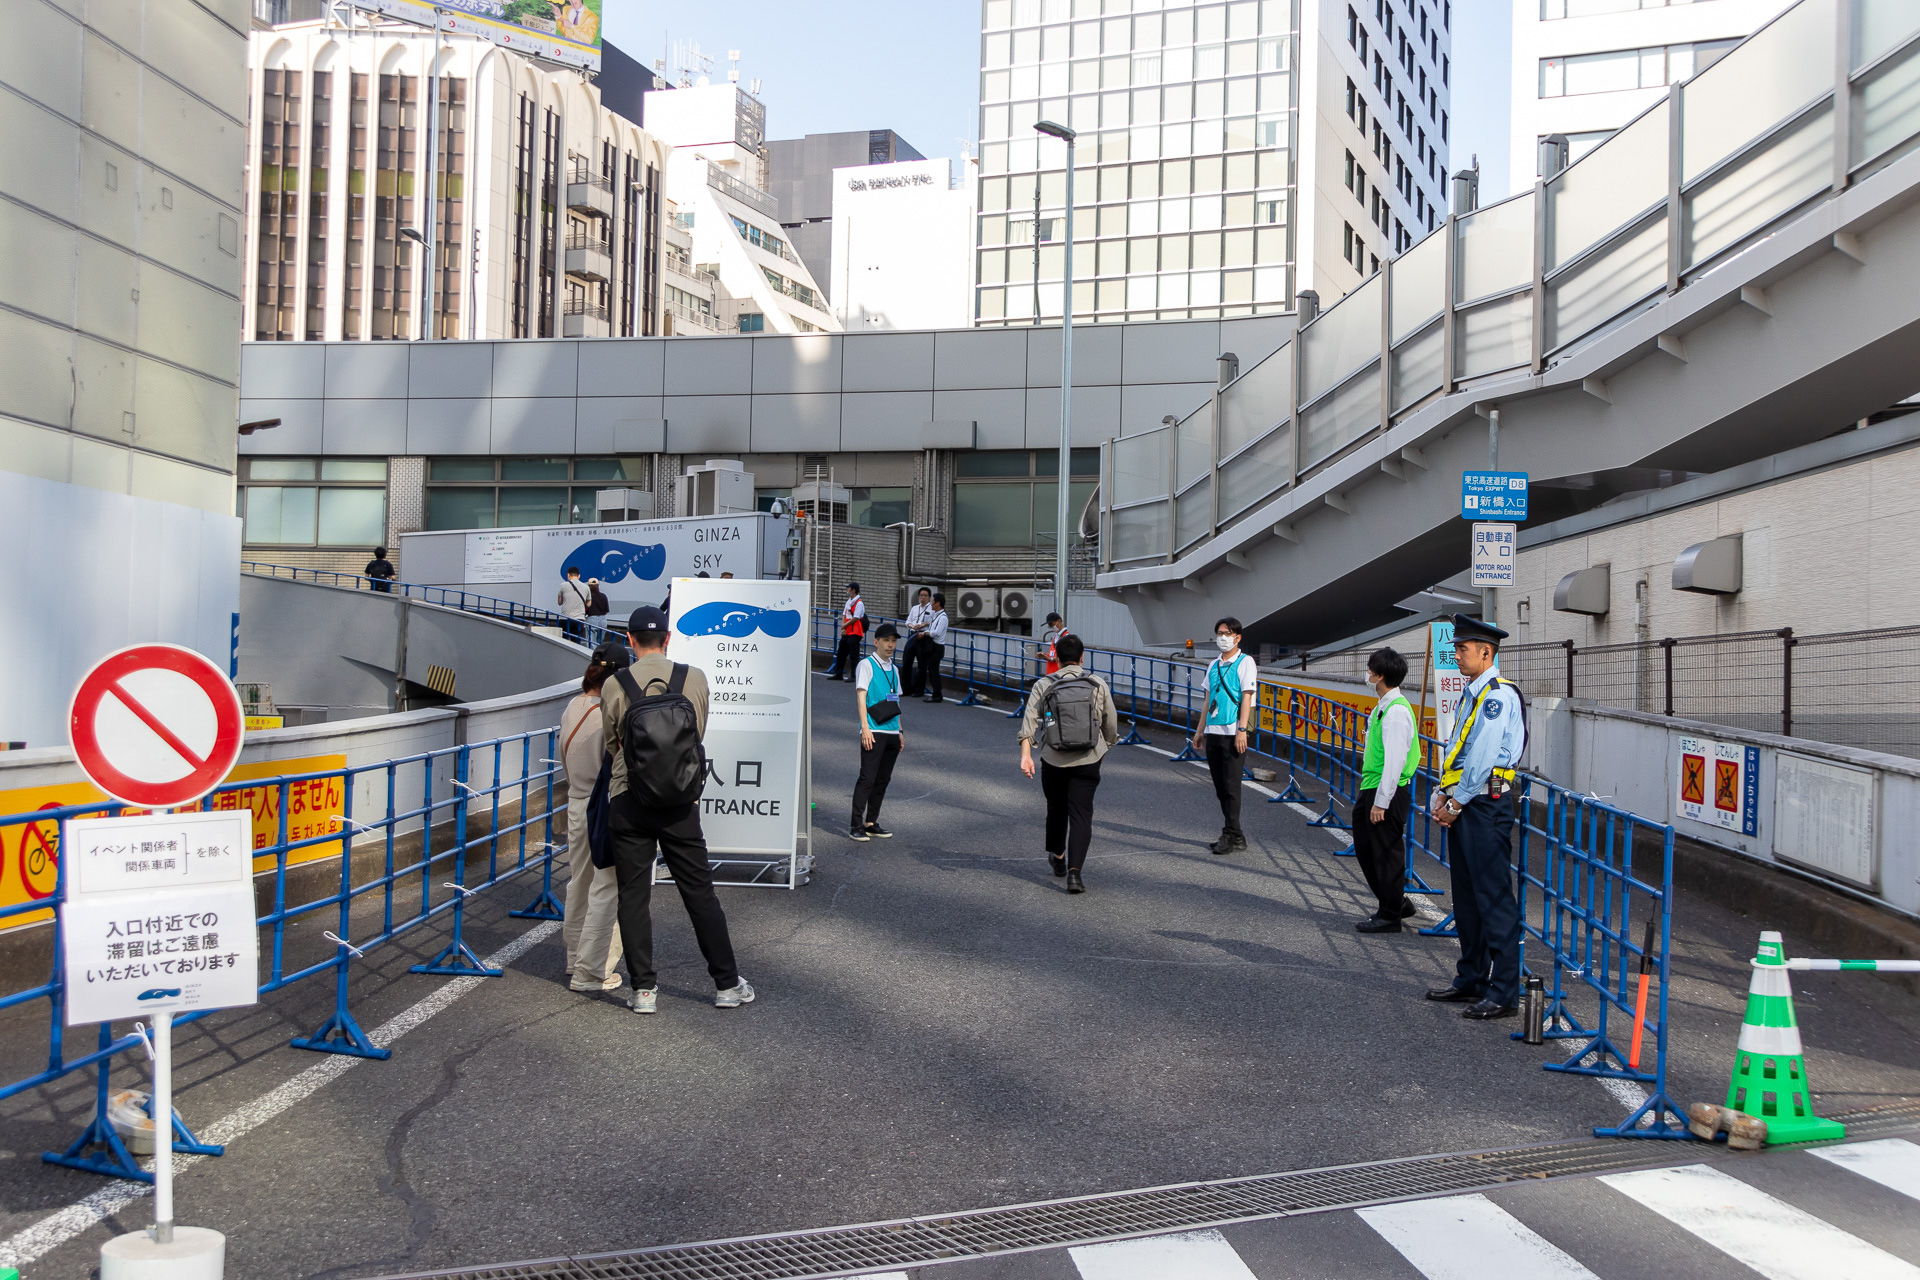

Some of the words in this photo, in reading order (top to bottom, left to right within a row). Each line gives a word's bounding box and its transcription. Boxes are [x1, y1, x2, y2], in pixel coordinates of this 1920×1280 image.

[1464, 475, 1508, 486] 東京高速道路
[1511, 479, 1524, 489] D8
[1468, 497, 1474, 507] 1
[1503, 508, 1526, 516] Entrance
[694, 526, 741, 543] GINZA
[1476, 531, 1513, 543] 自動車道
[1477, 544, 1511, 557] 入口
[693, 553, 723, 569] SKY
[1475, 563, 1495, 571] MOTOR
[1475, 572, 1512, 580] ENTRANCE
[1438, 628, 1455, 643] 八
[717, 642, 759, 653] GINZA
[716, 658, 743, 668] SKY
[715, 675, 754, 685] WALK
[713, 692, 747, 702] 2024
[1681, 739, 1706, 753] ほこうしゃ
[1714, 742, 1739, 759] じてんしゃ
[1745, 749, 1756, 832] はいっちゃだめ
[89, 839, 179, 857] イベント関係者
[196, 845, 230, 858] を除く
[125, 858, 176, 873] 関係車両
[106, 911, 219, 938] 入口付近での
[107, 932, 220, 961] 滞留はご遠慮
[87, 952, 241, 983] いただいております
